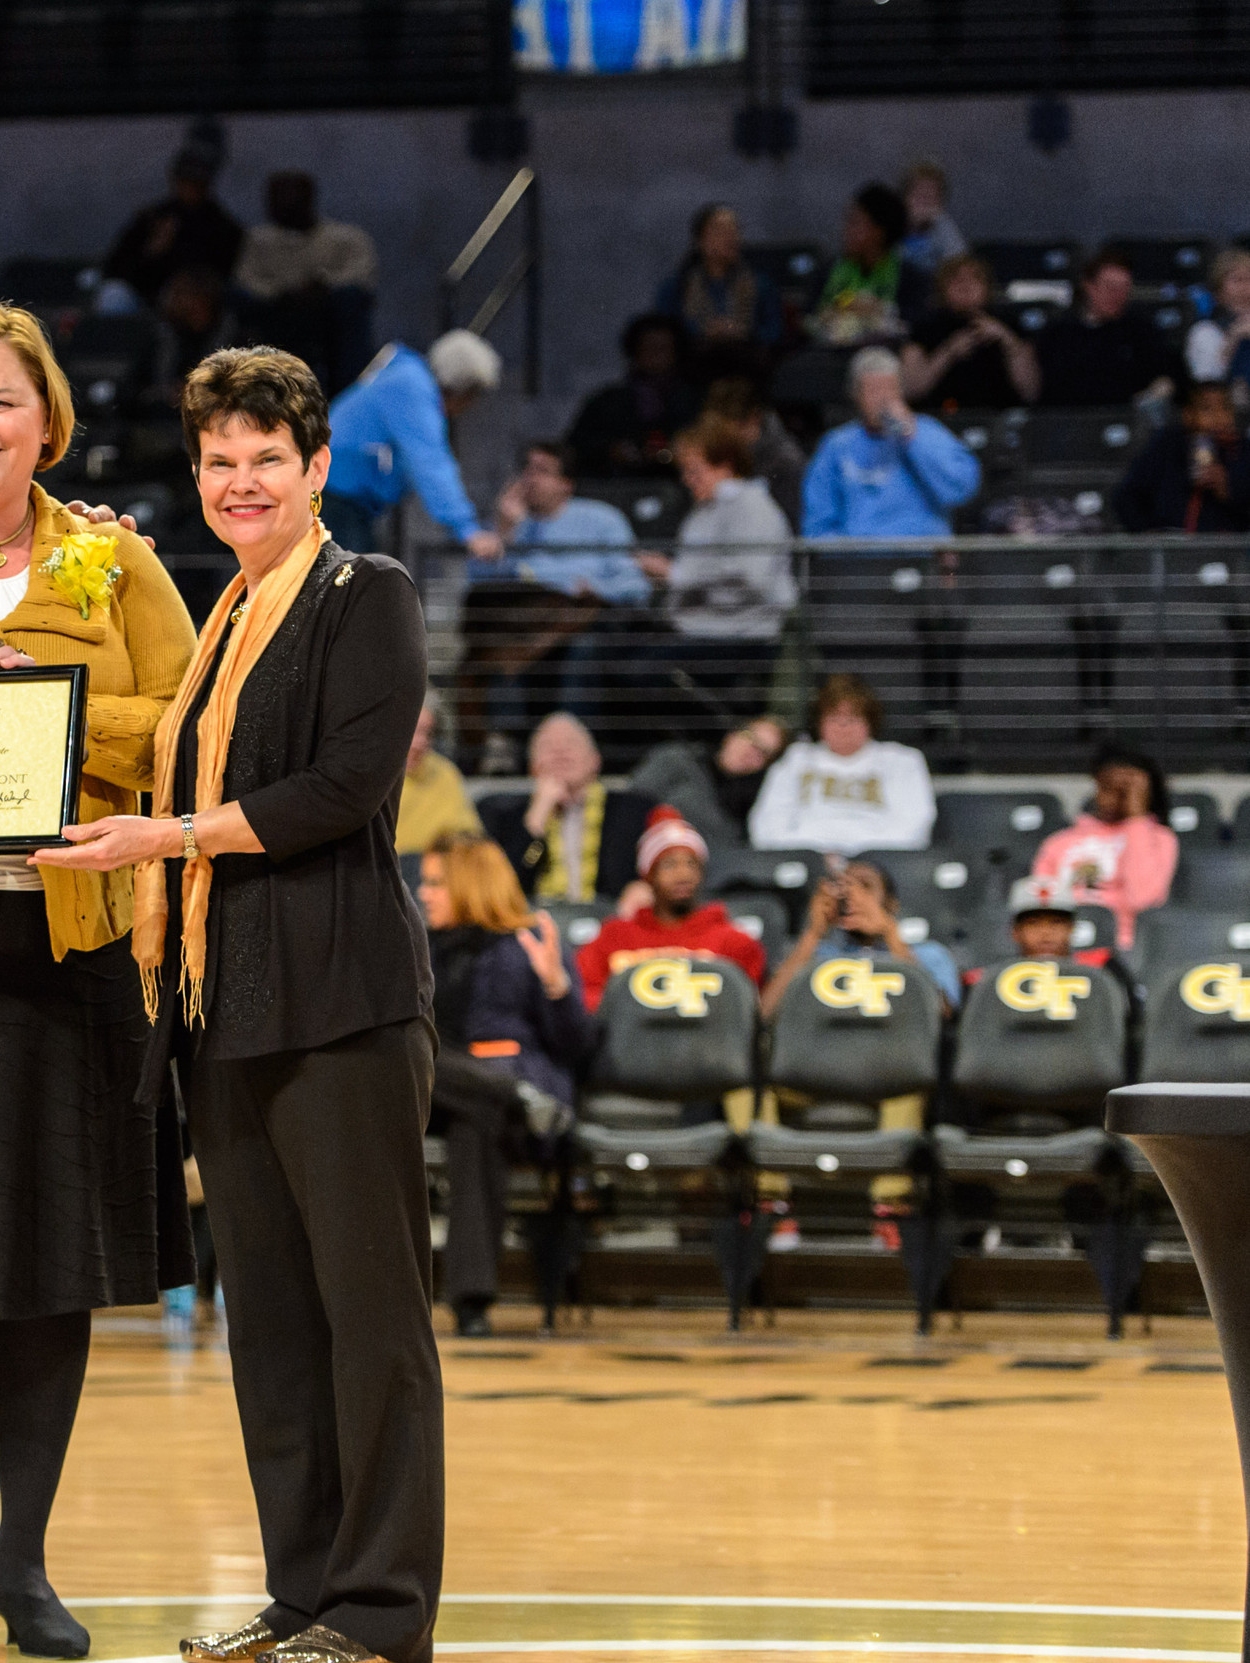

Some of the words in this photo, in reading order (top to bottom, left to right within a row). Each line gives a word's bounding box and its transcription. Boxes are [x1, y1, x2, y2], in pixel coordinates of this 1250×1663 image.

[628, 958, 724, 1018] GT
[810, 958, 906, 1018] GT
[996, 961, 1092, 1021] GT
